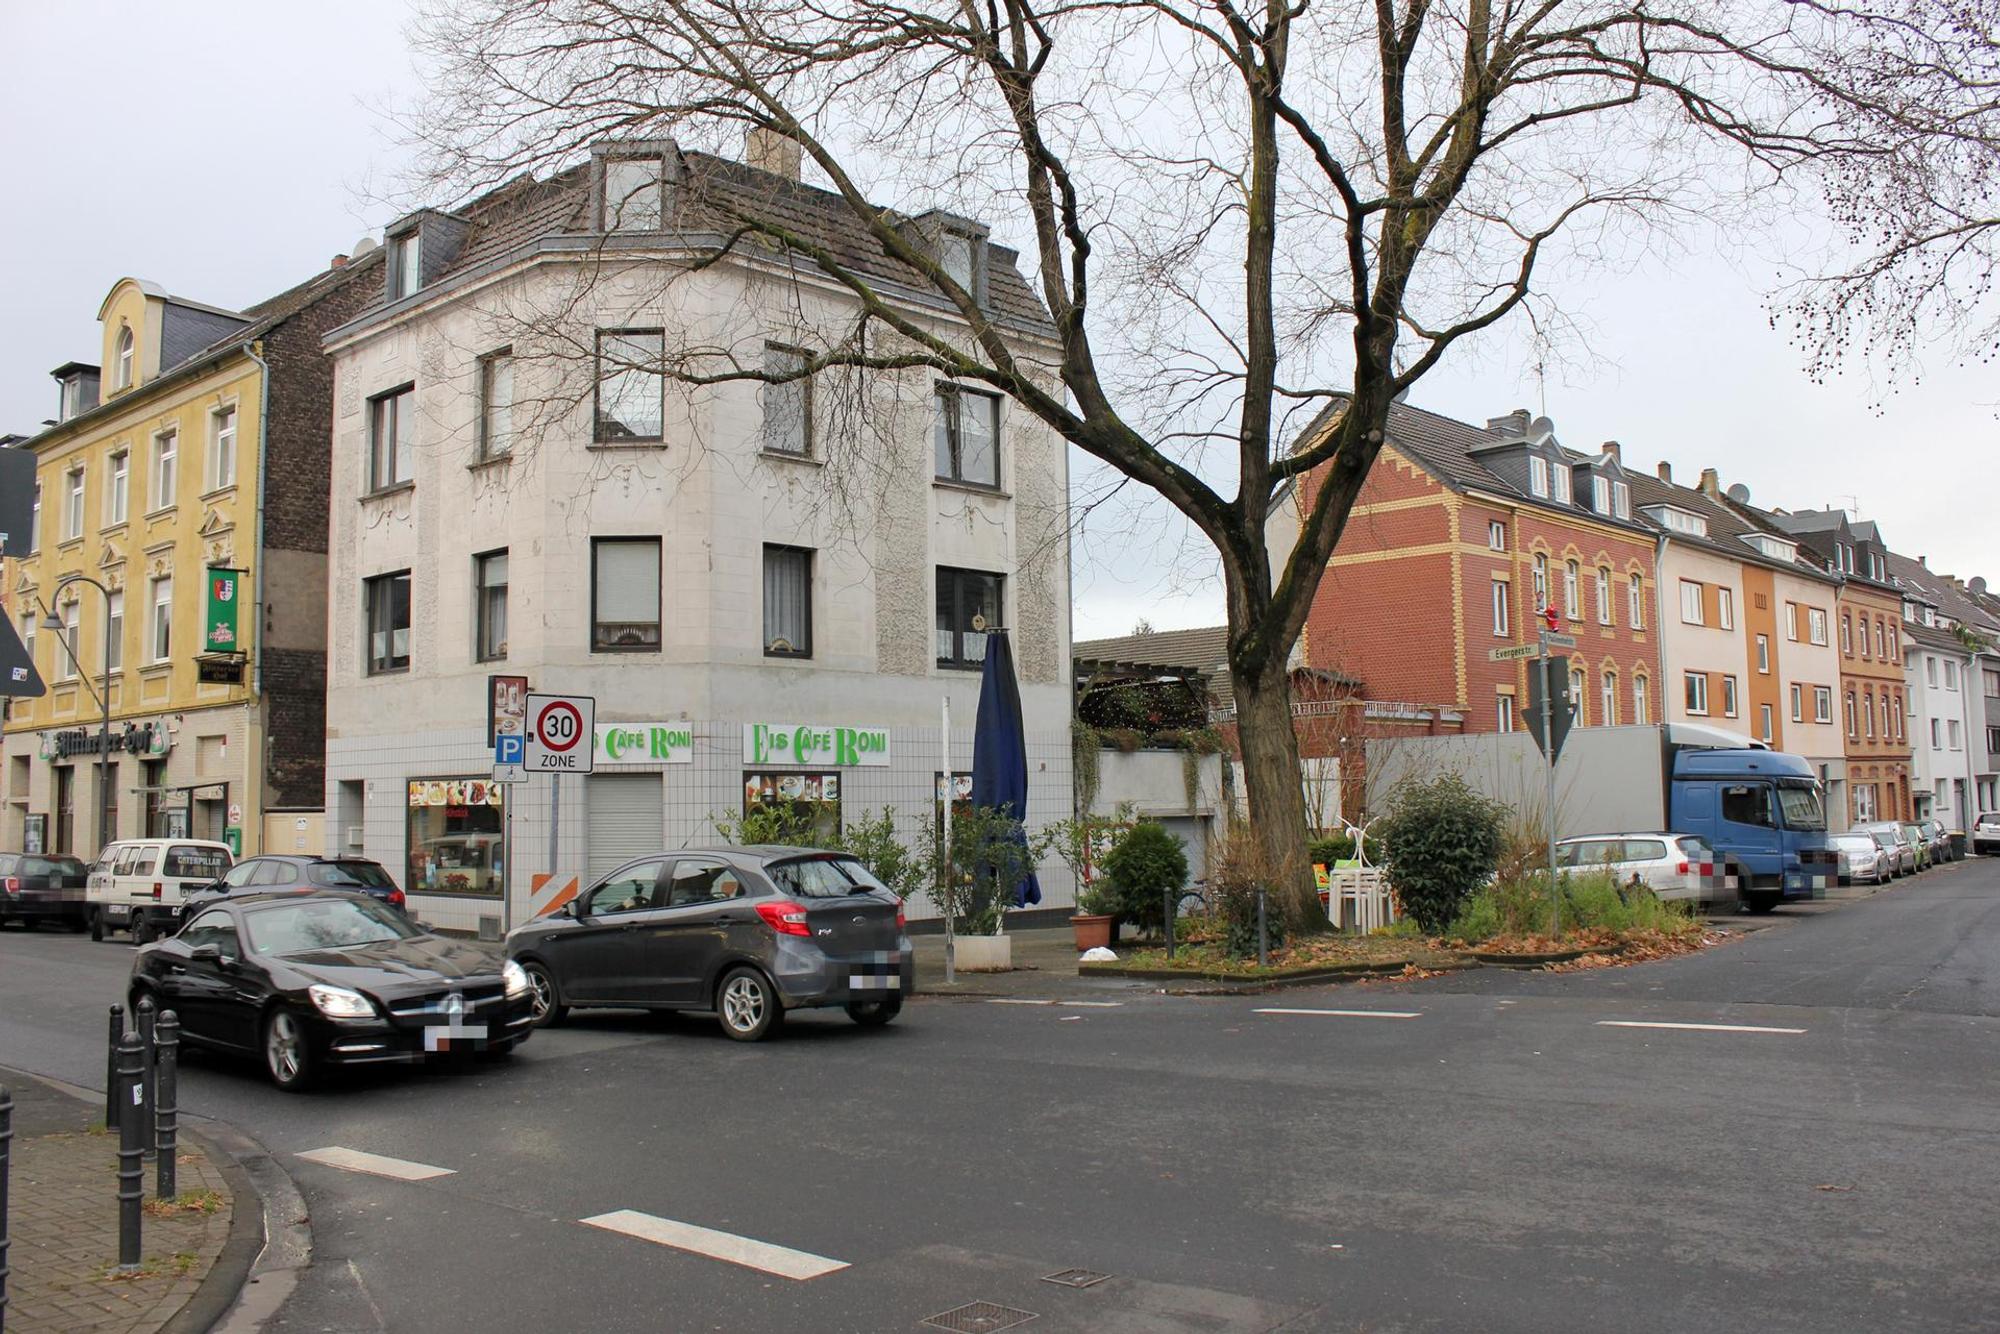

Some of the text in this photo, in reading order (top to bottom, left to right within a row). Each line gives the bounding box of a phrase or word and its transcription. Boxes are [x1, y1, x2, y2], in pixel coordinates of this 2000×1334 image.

[1496, 647, 1532, 658] Evergerstr.
[546, 715, 573, 738] 30
[502, 738, 520, 762] P
[541, 754, 576, 768] ZONE
